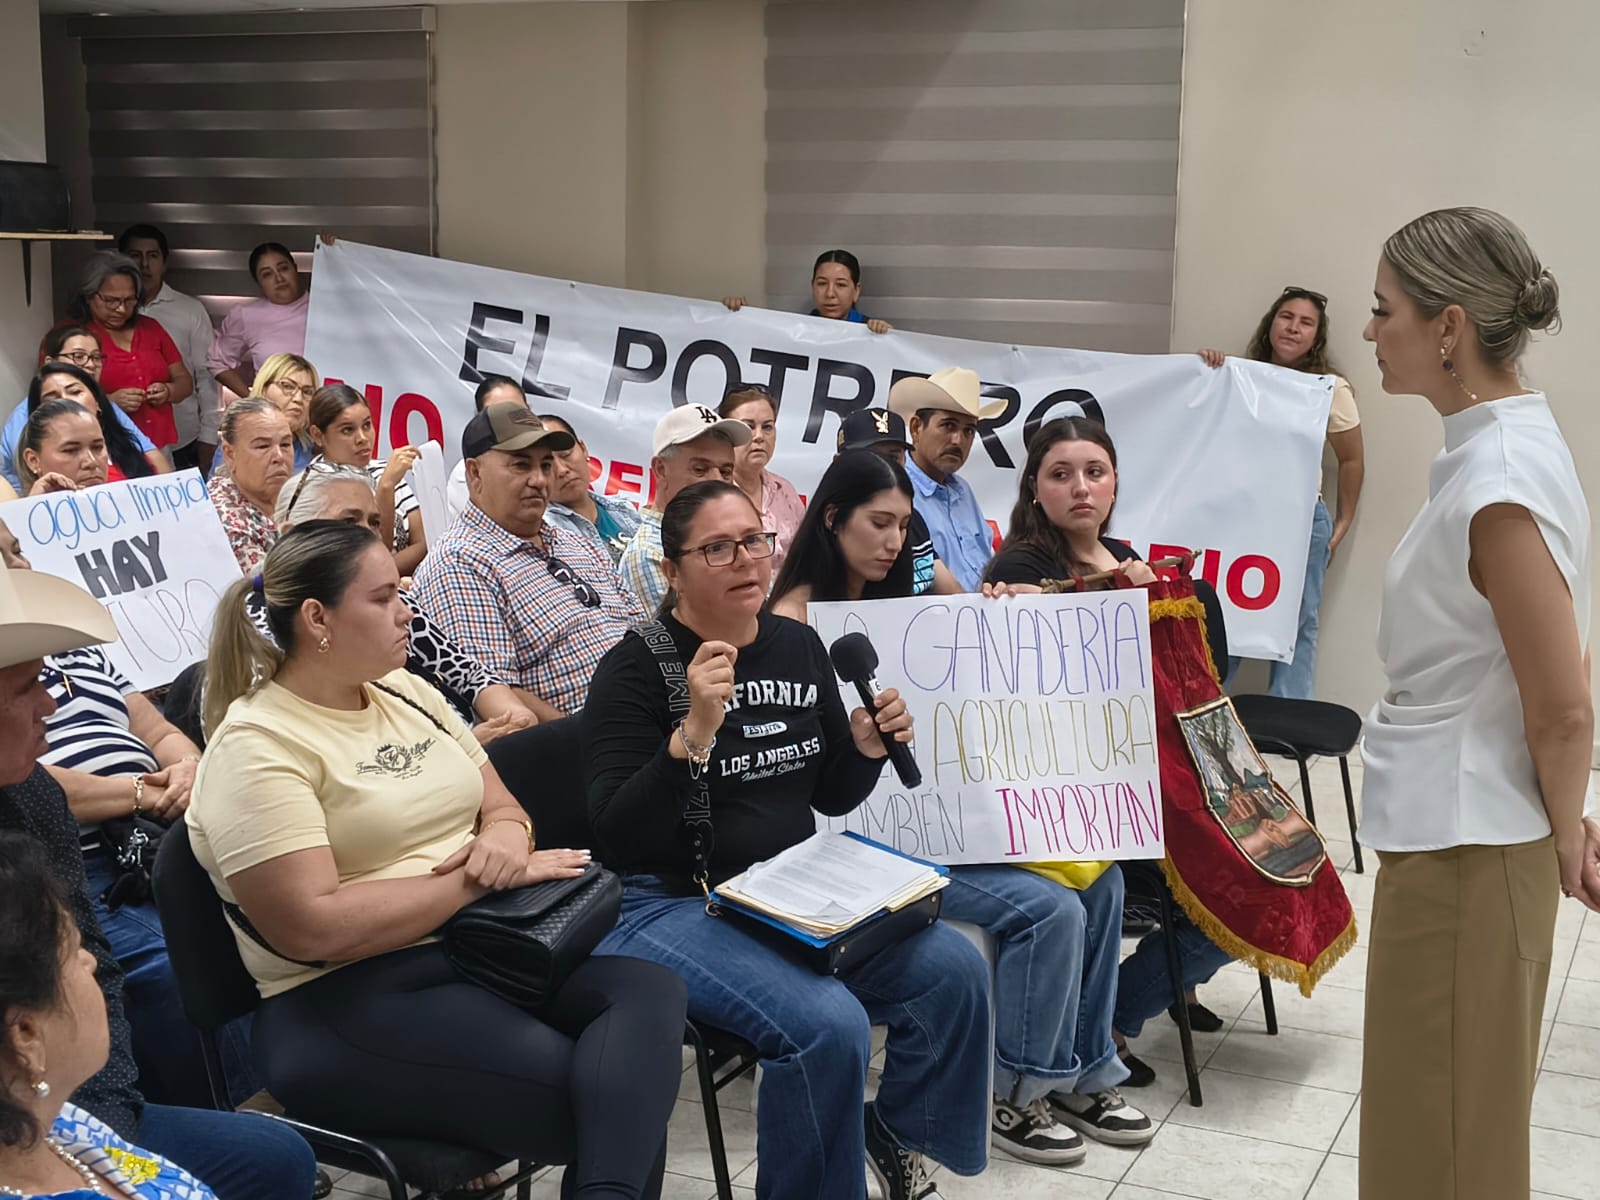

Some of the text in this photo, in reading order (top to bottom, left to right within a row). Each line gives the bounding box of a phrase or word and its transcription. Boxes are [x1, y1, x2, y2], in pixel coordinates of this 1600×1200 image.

[458, 301, 1106, 469] EL POTRRO
[695, 406, 717, 423] LA
[28, 476, 209, 550] agua limpia
[74, 531, 168, 598] HAY
[902, 598, 1145, 696] GANADERÍA
[723, 680, 819, 713] FORNIA
[719, 736, 820, 777] LOS ANGELES
[934, 694, 1156, 785] AGRICULTURA
[995, 780, 1161, 856] IMPORTAN
